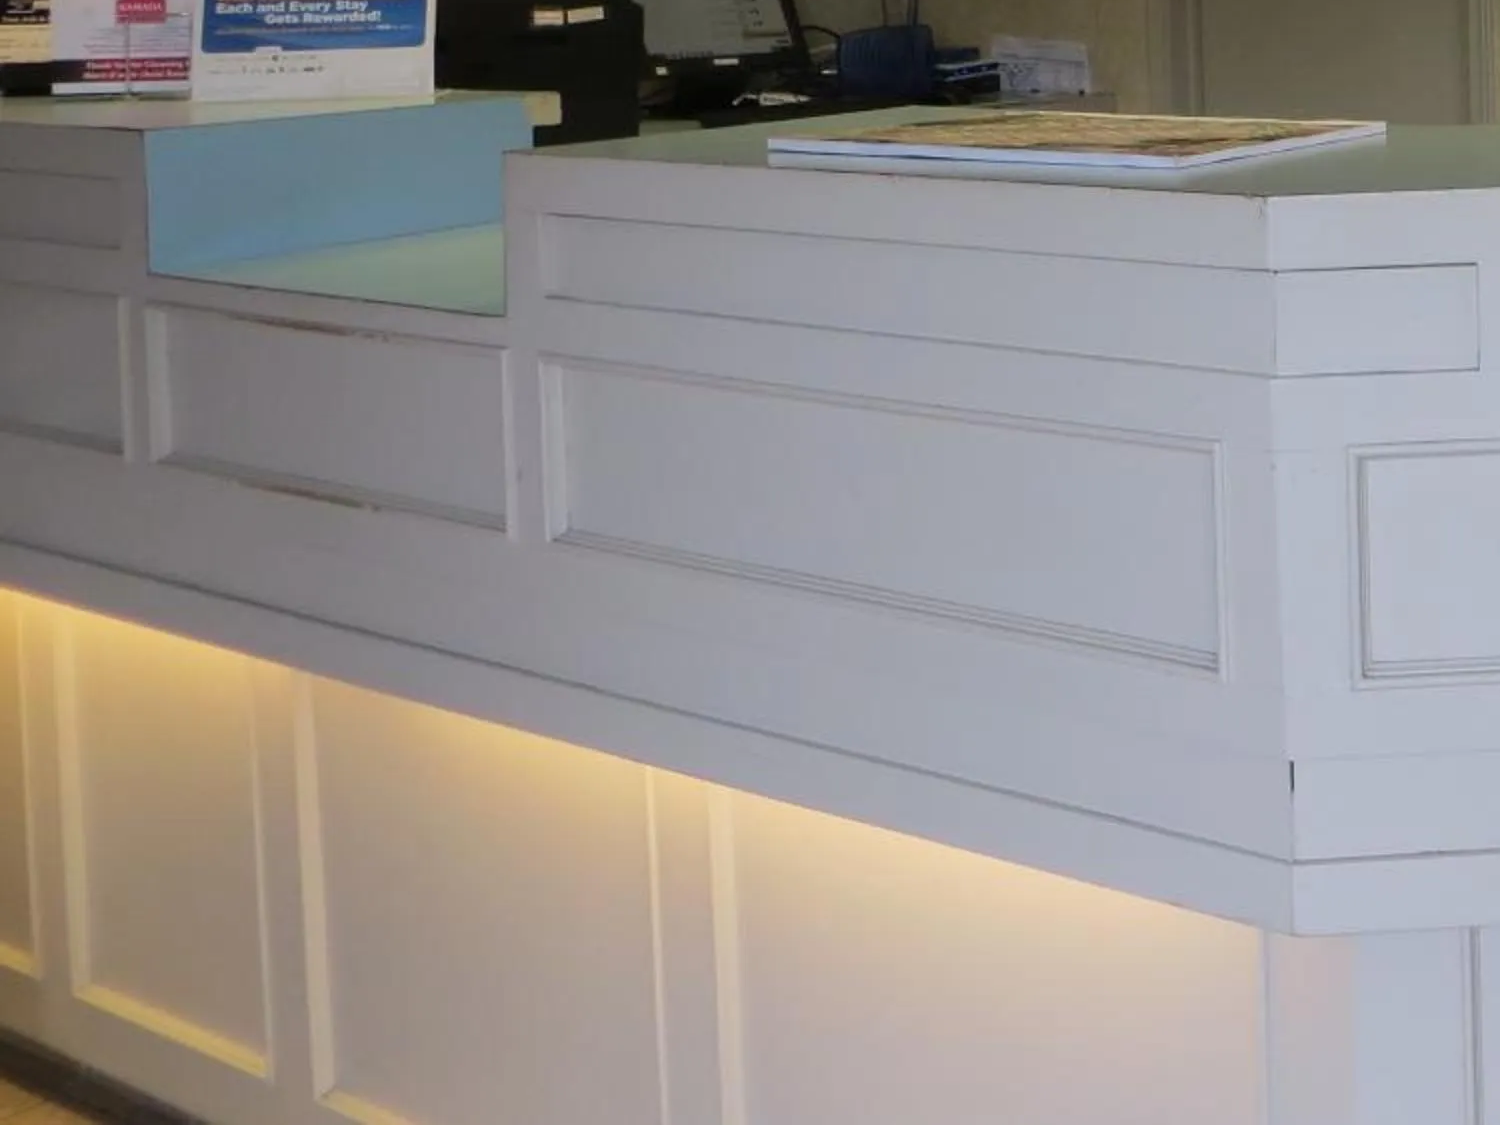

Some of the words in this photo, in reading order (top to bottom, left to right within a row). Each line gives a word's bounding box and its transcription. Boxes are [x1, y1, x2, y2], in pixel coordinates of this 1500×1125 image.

[119, 2, 164, 13] RAMADA
[215, 1, 253, 14] Each
[256, 1, 286, 13] and
[289, 1, 331, 14] Every
[336, 0, 369, 13] Stay
[264, 13, 299, 24] Gets
[303, 11, 381, 24] Rewarded!
